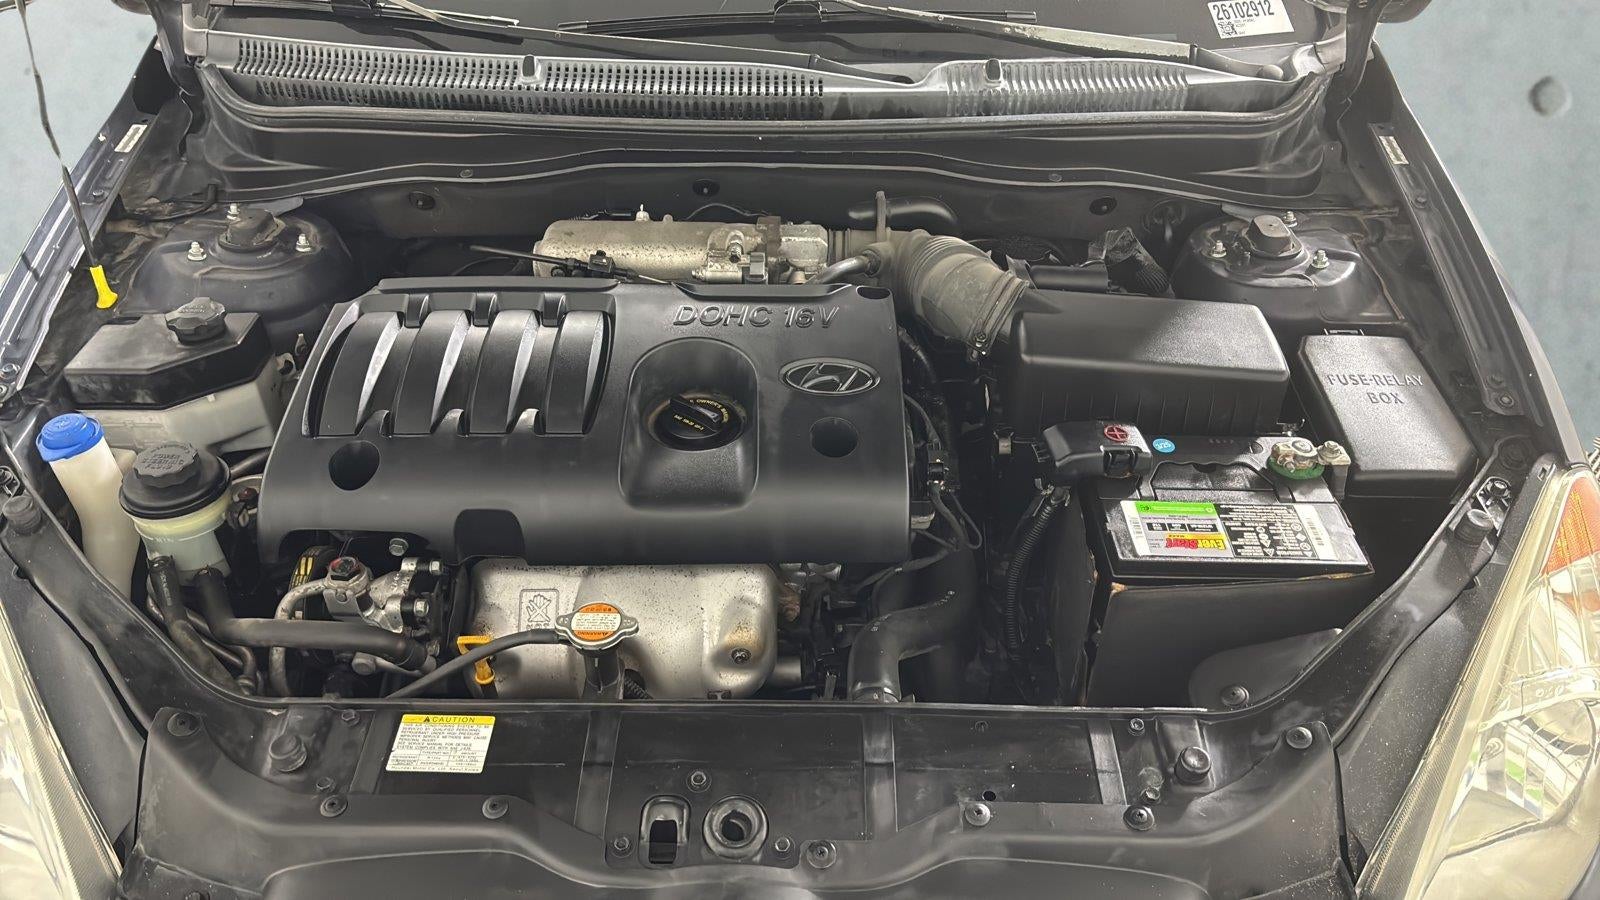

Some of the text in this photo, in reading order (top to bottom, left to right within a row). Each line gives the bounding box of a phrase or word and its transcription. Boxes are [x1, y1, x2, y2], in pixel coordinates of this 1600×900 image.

[1213, 0, 1274, 20] 26102912
[673, 304, 840, 328] DOHC 16V
[1326, 374, 1424, 386] FUSE-RELAY
[1366, 392, 1404, 404] BOX
